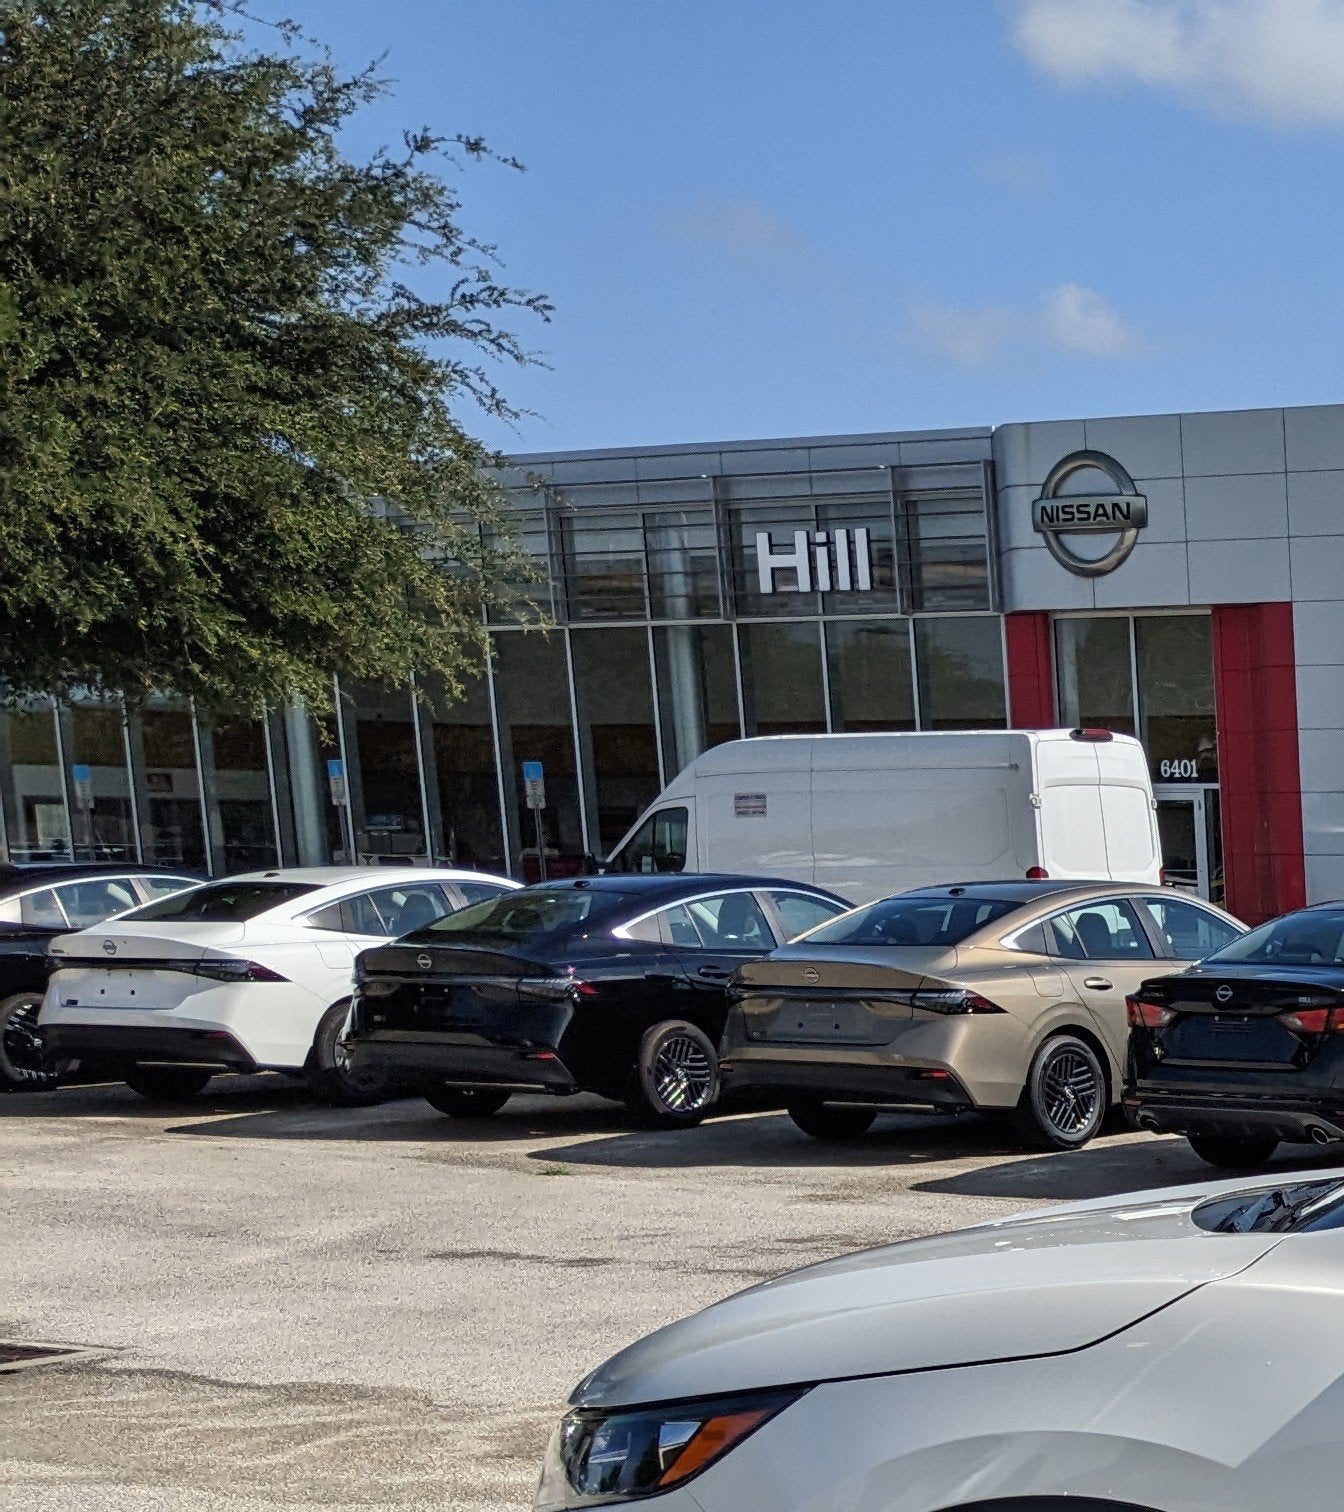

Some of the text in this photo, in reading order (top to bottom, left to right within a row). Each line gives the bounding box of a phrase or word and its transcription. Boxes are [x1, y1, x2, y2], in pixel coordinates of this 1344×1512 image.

[1041, 502, 1131, 524] NISSAN
[756, 527, 871, 594] Hill
[1160, 759, 1199, 778] 6401
